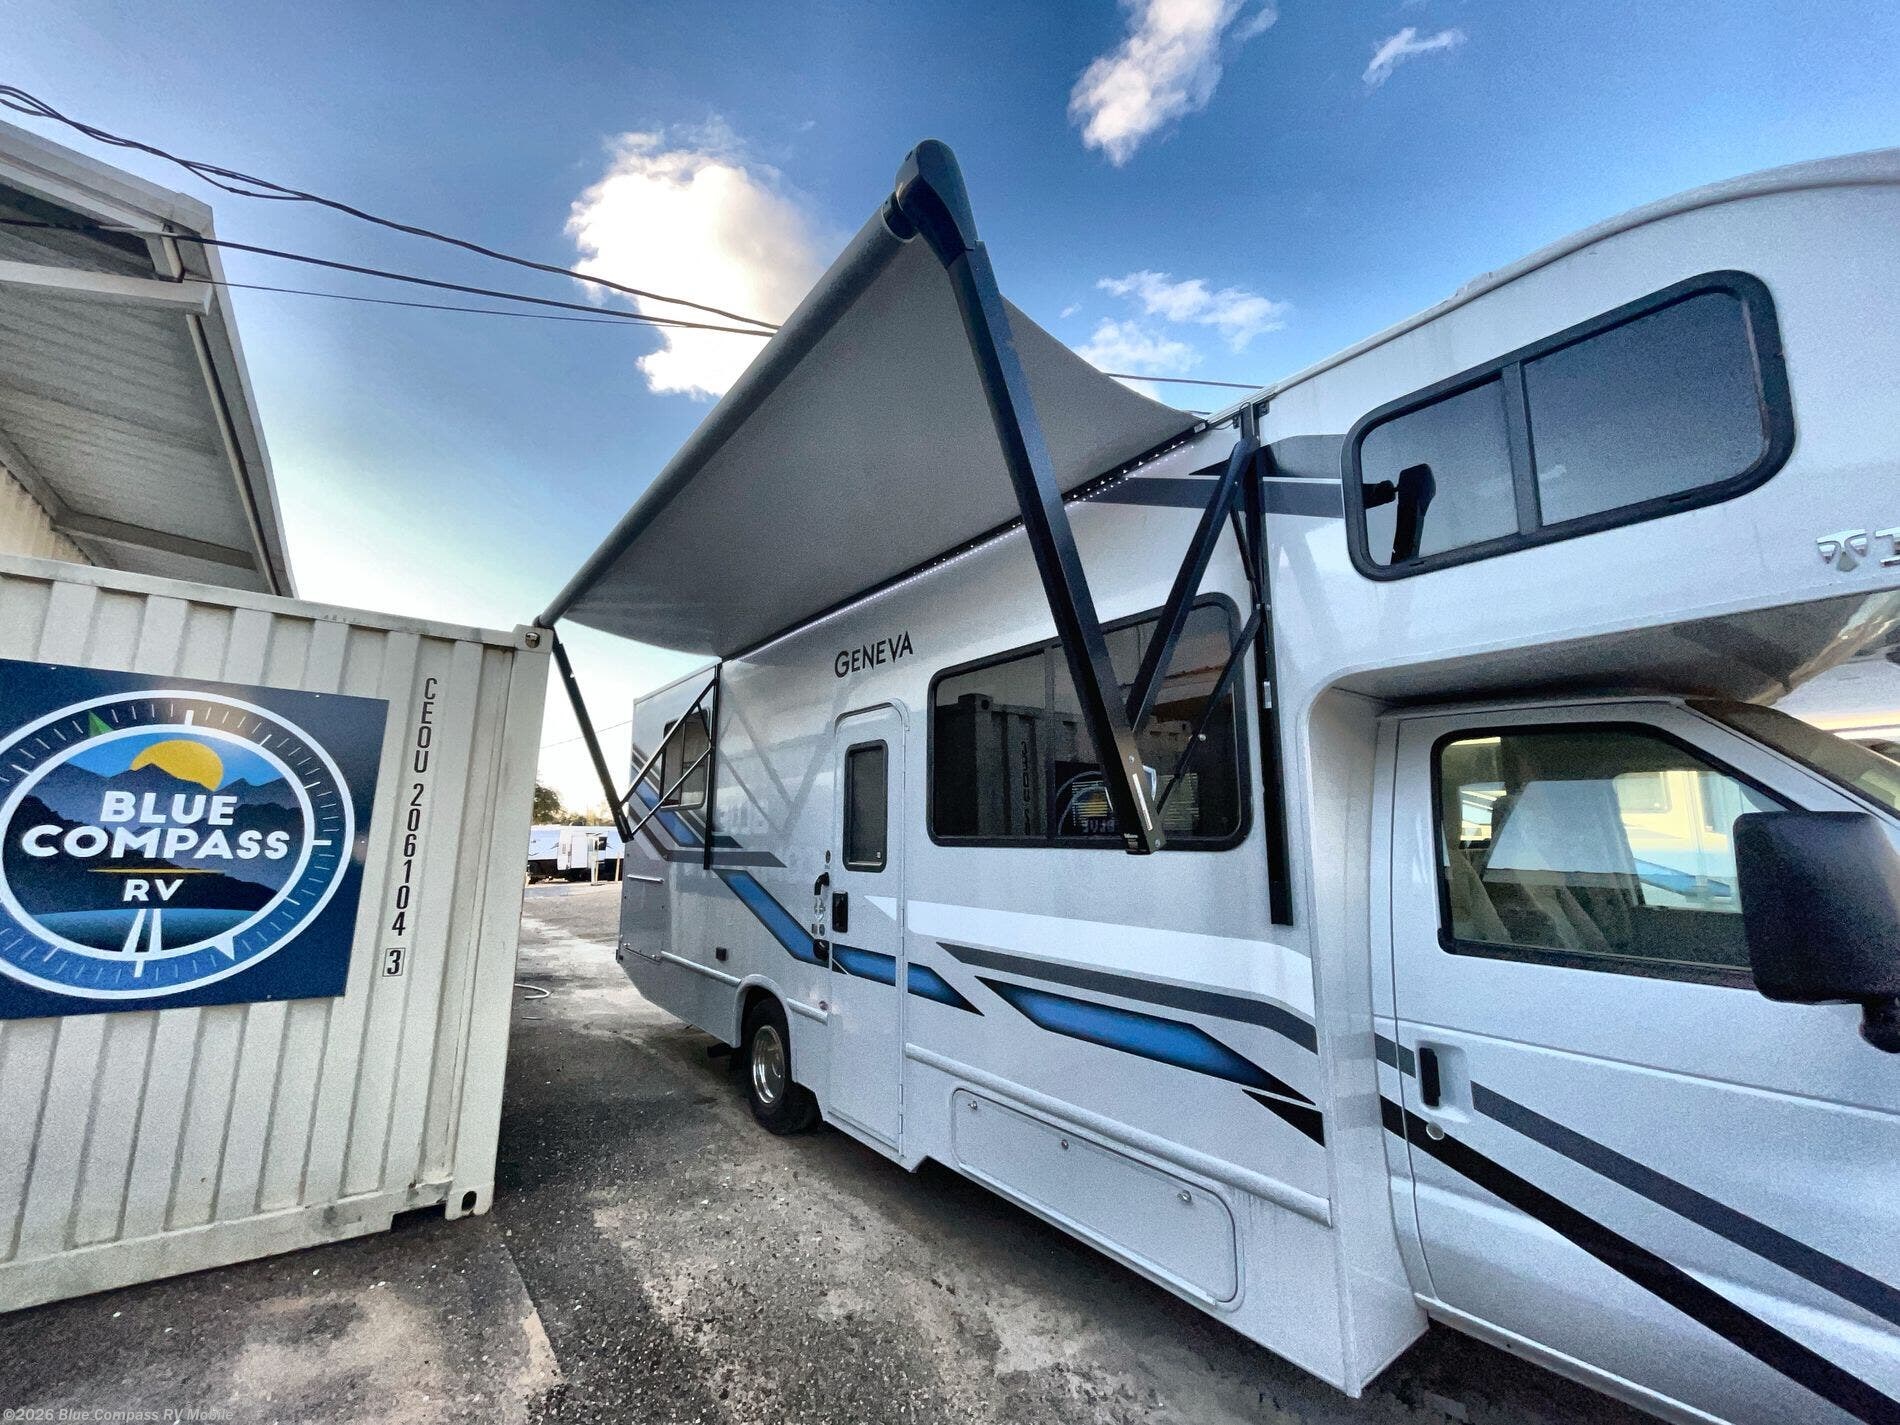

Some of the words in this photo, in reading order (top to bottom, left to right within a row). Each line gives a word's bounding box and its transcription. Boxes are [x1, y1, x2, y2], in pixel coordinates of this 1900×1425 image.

[834, 630, 913, 678] GENEVA
[414, 677, 438, 774] CEOU
[100, 791, 237, 825] BLUE
[21, 824, 290, 860] COMPASS
[391, 783, 424, 936] 206104
[123, 878, 184, 902] RV
[387, 949, 401, 975] 3
